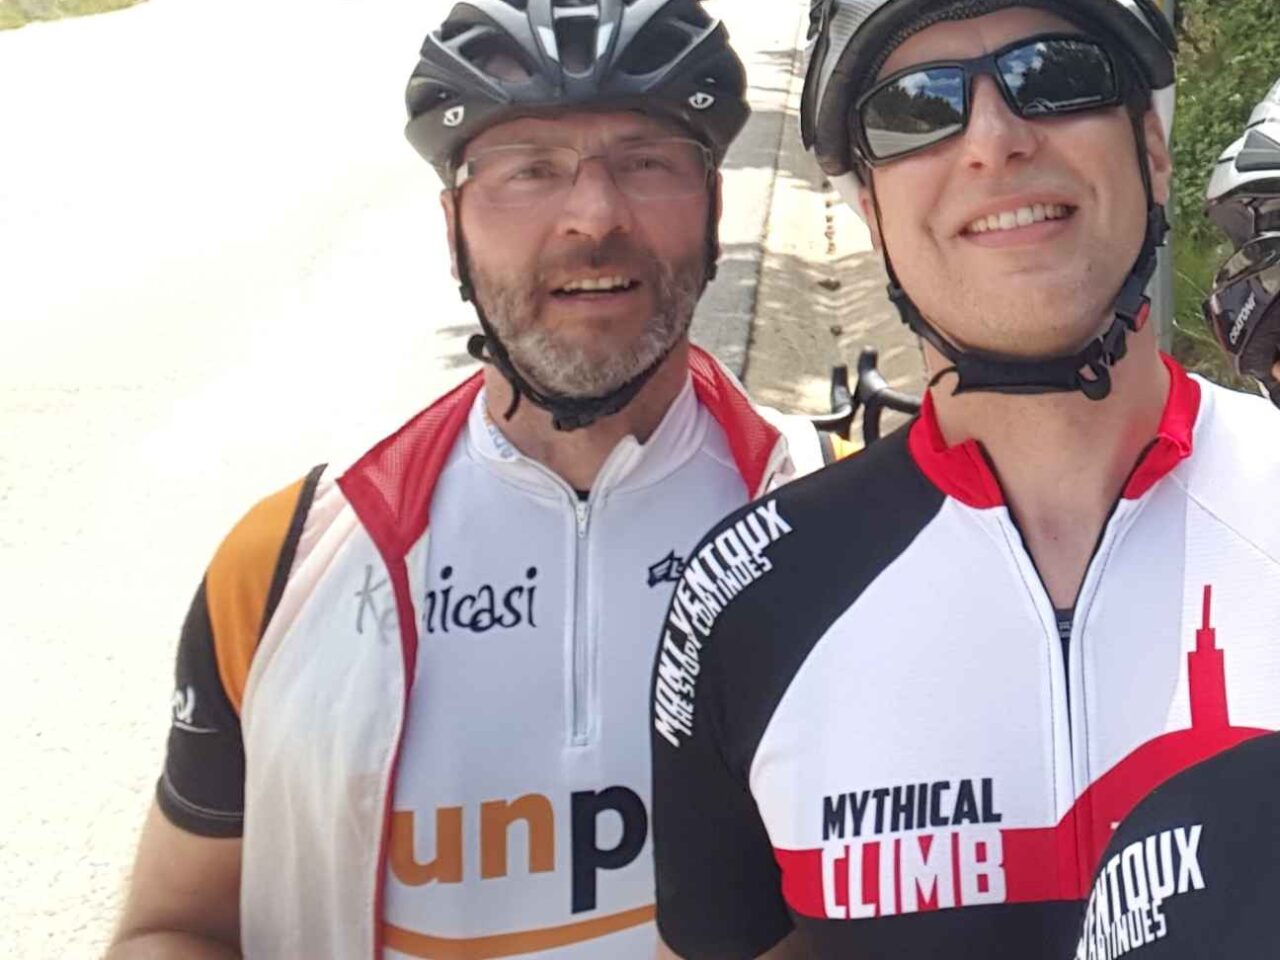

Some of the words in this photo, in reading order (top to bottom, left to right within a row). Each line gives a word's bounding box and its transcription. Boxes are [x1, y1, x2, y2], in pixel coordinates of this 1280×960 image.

[669, 499, 793, 639] VENTOUX
[654, 629, 689, 748] MONT
[822, 777, 1003, 841] MYTHICAL
[821, 826, 1007, 920] CLIMB
